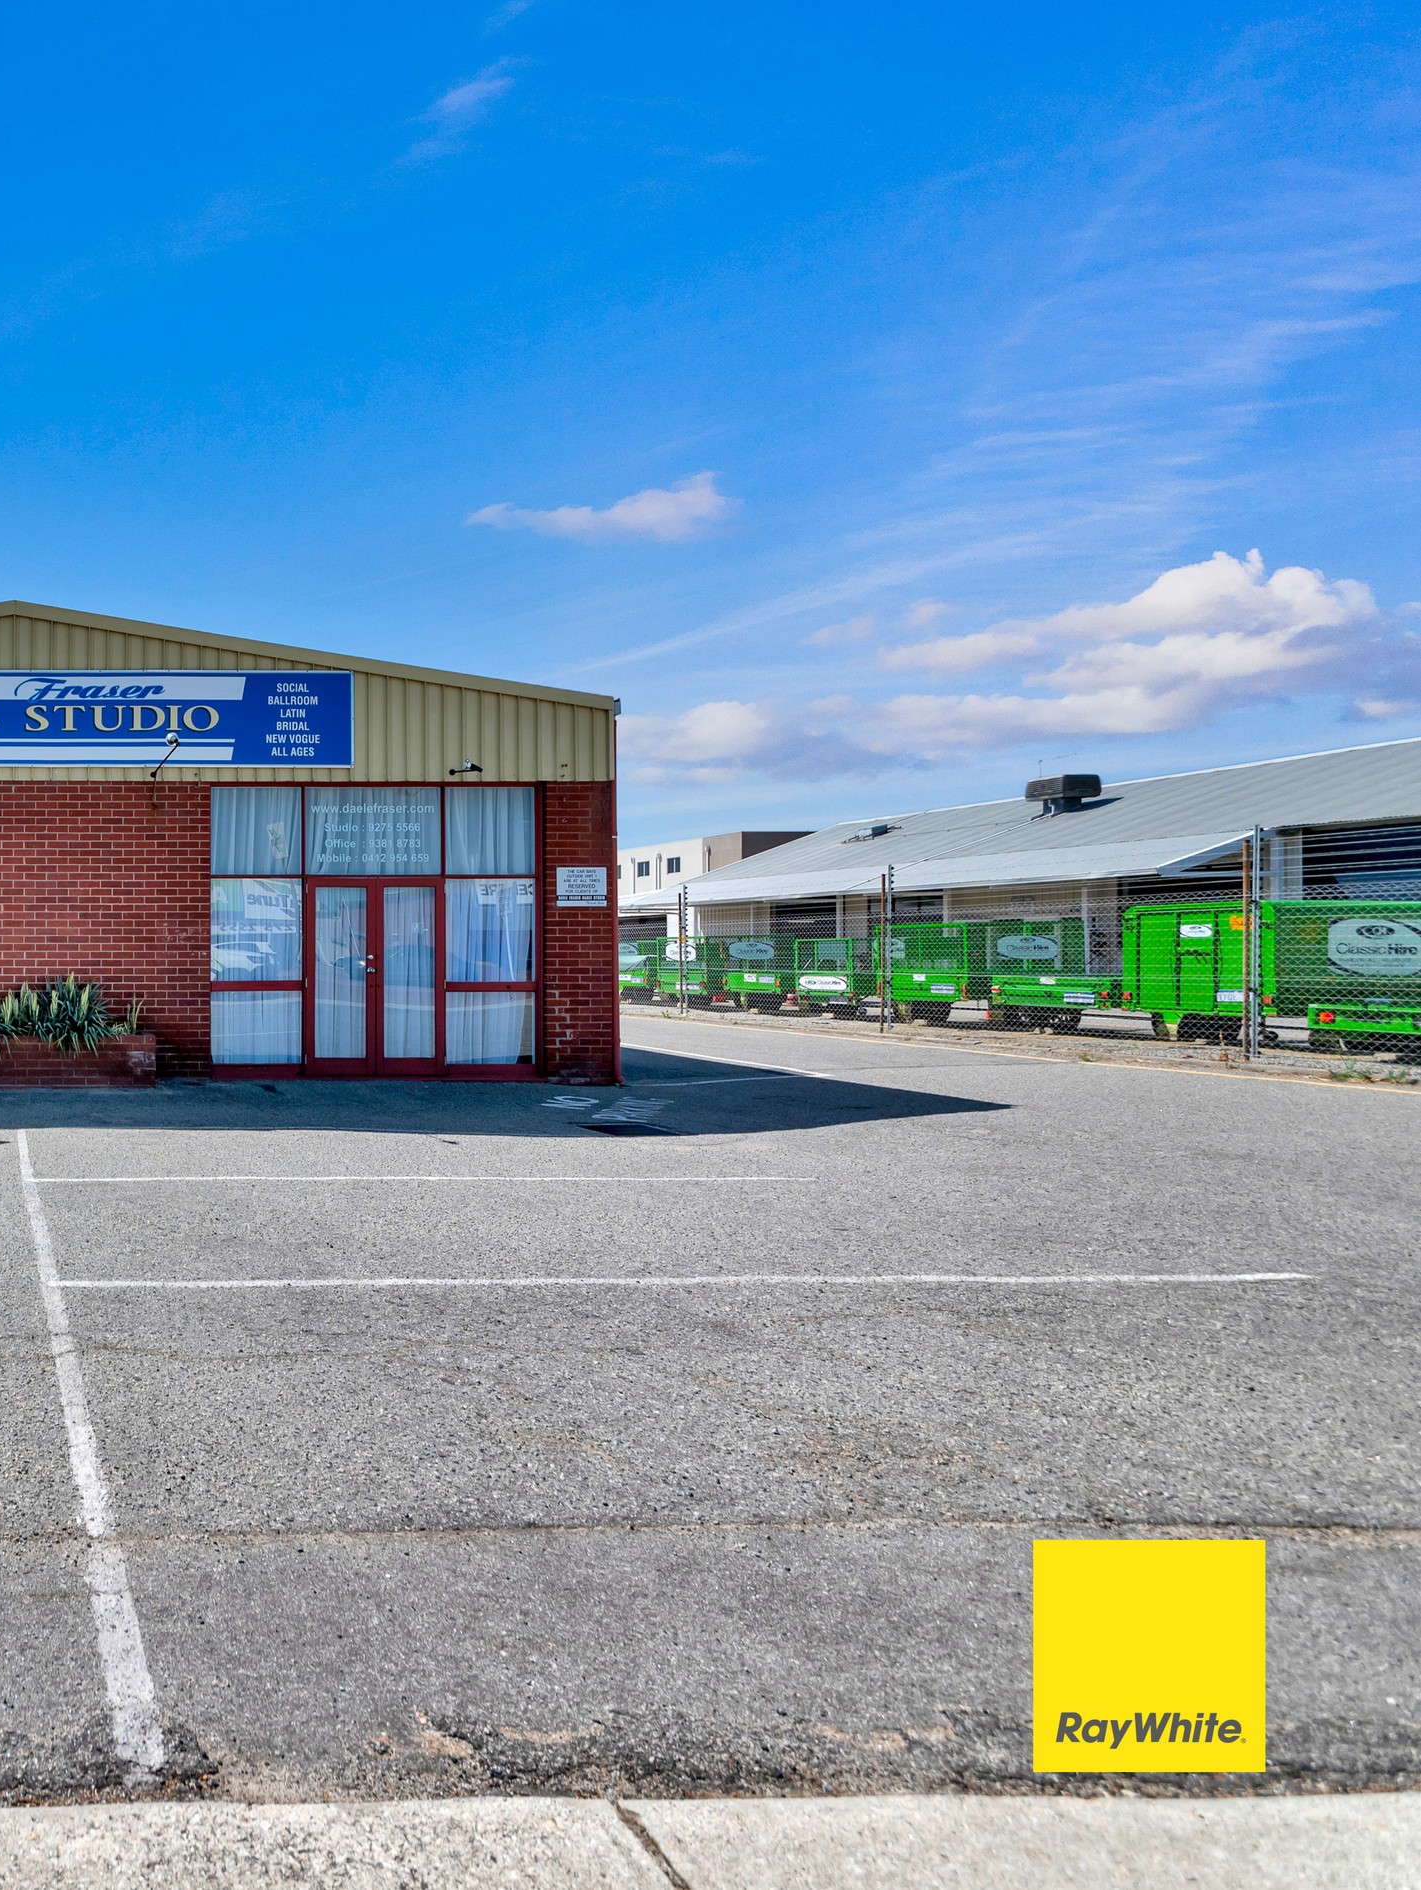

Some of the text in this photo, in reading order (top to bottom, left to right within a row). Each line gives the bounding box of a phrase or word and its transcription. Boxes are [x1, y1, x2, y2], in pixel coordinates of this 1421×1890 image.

[14, 677, 166, 703] Fraser
[276, 683, 310, 693] SOCIAL
[267, 696, 319, 706] BALLROOM
[24, 704, 220, 732] STUDIO
[280, 708, 306, 718] LATIN
[276, 721, 310, 731] BRIDAL
[265, 734, 321, 744] NEW VOGUE
[270, 747, 315, 757] ALL AGES
[310, 803, 435, 814] www.daelefraser.com
[324, 823, 358, 832] Studio
[368, 823, 393, 832] 9275
[396, 823, 421, 832] 5566
[324, 838, 356, 848] Office
[369, 839, 393, 848] 9381
[396, 839, 421, 848] 8783
[316, 853, 352, 863] Mobile
[361, 854, 387, 863] 0412
[389, 854, 408, 863] 954
[411, 854, 430, 863] 659
